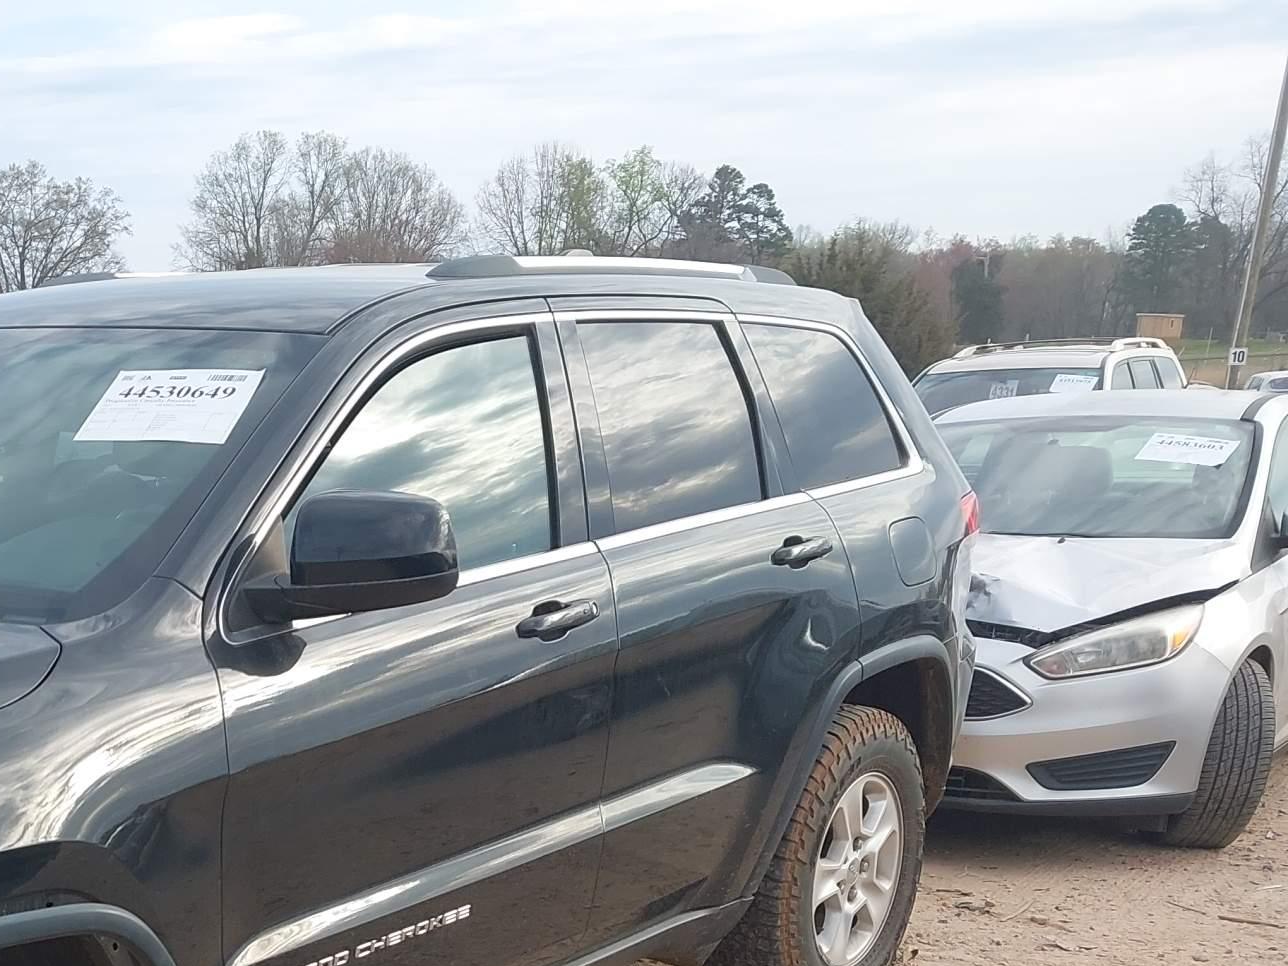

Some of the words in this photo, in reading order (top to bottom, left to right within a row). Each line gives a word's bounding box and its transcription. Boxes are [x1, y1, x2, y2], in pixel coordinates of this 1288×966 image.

[1232, 350, 1246, 363] 10
[118, 385, 237, 400] 44530649
[354, 904, 472, 958] CHEROKEE
